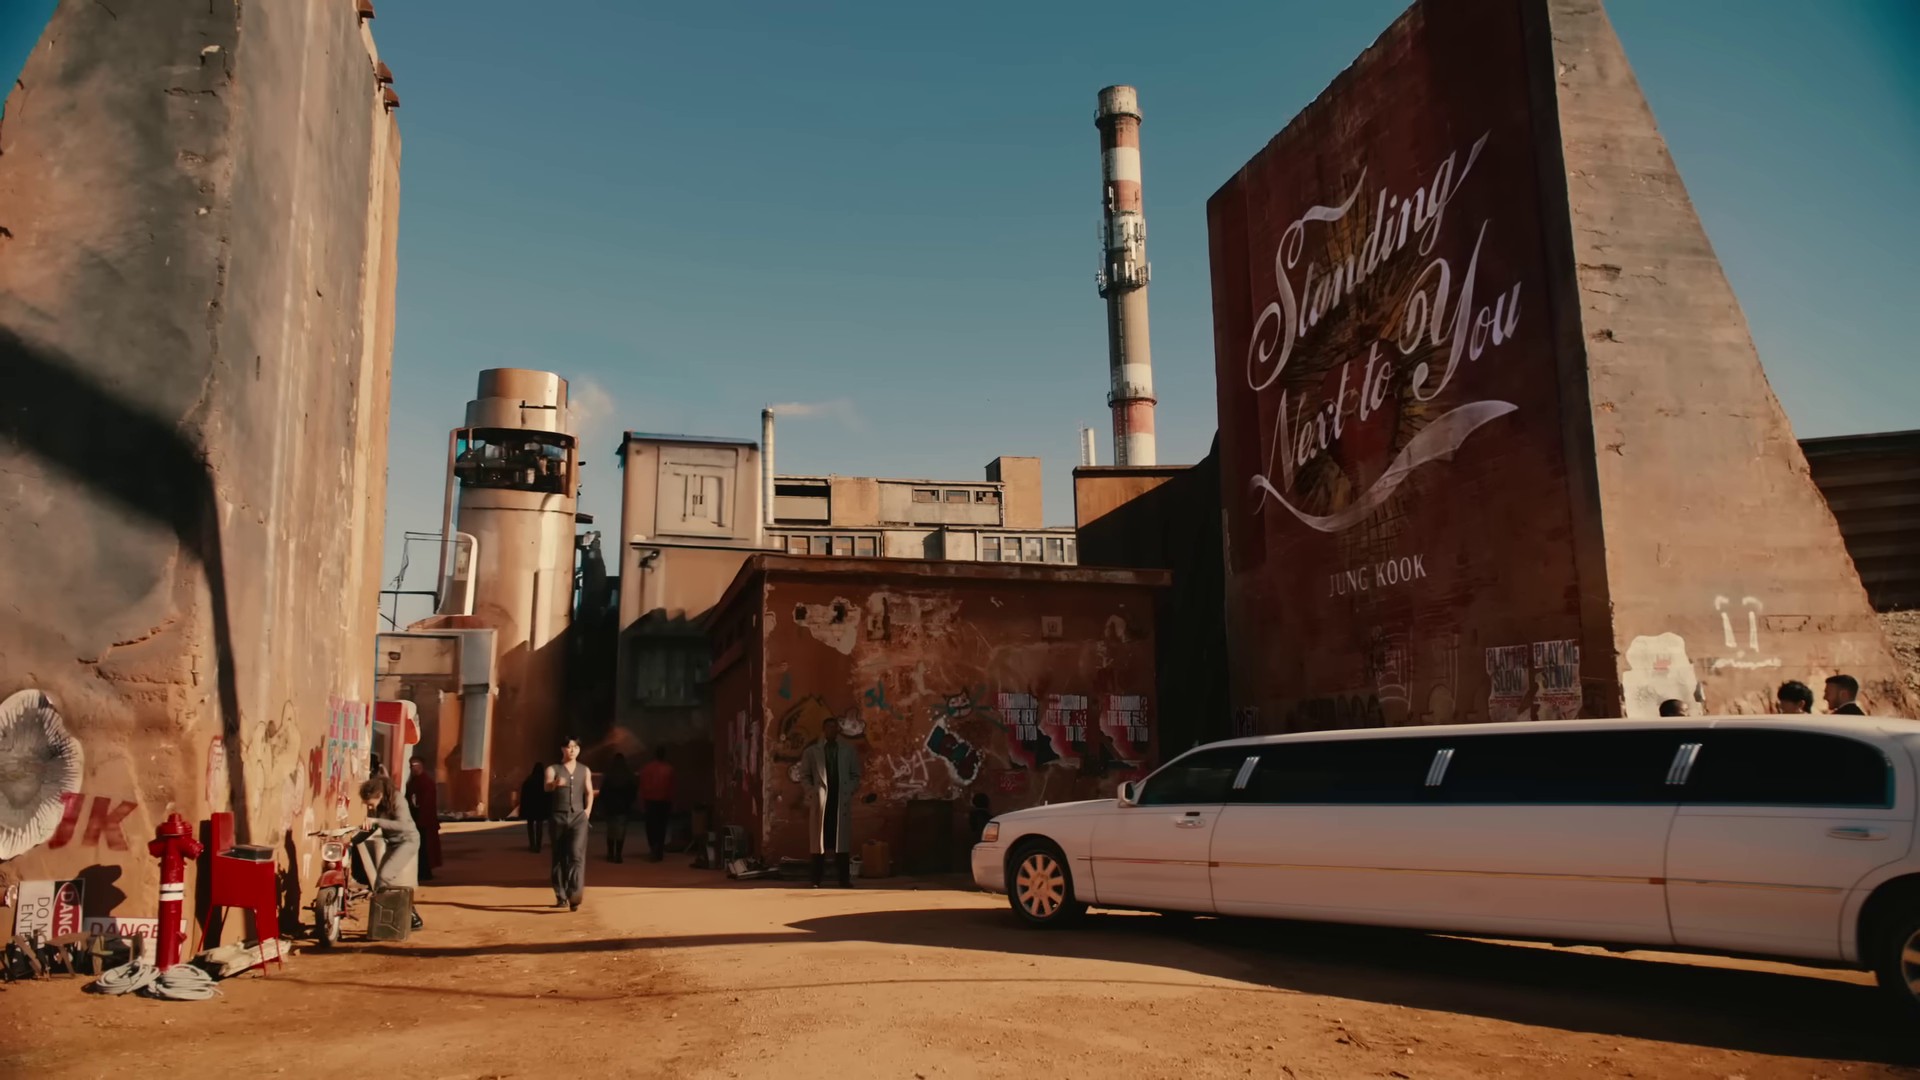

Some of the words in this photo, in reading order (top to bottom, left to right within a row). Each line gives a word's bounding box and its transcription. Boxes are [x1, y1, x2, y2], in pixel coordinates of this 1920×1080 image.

[1247, 129, 1491, 391] Standing
[1253, 361, 1352, 515] Next
[1359, 341, 1396, 422] to
[1399, 218, 1522, 402] You
[1329, 566, 1369, 598] JUNG
[1375, 553, 1427, 588] KOOK
[48, 792, 138, 851] JK
[36, 897, 51, 919] DO
[58, 891, 75, 937] DANG
[90, 922, 160, 939] DANGE
